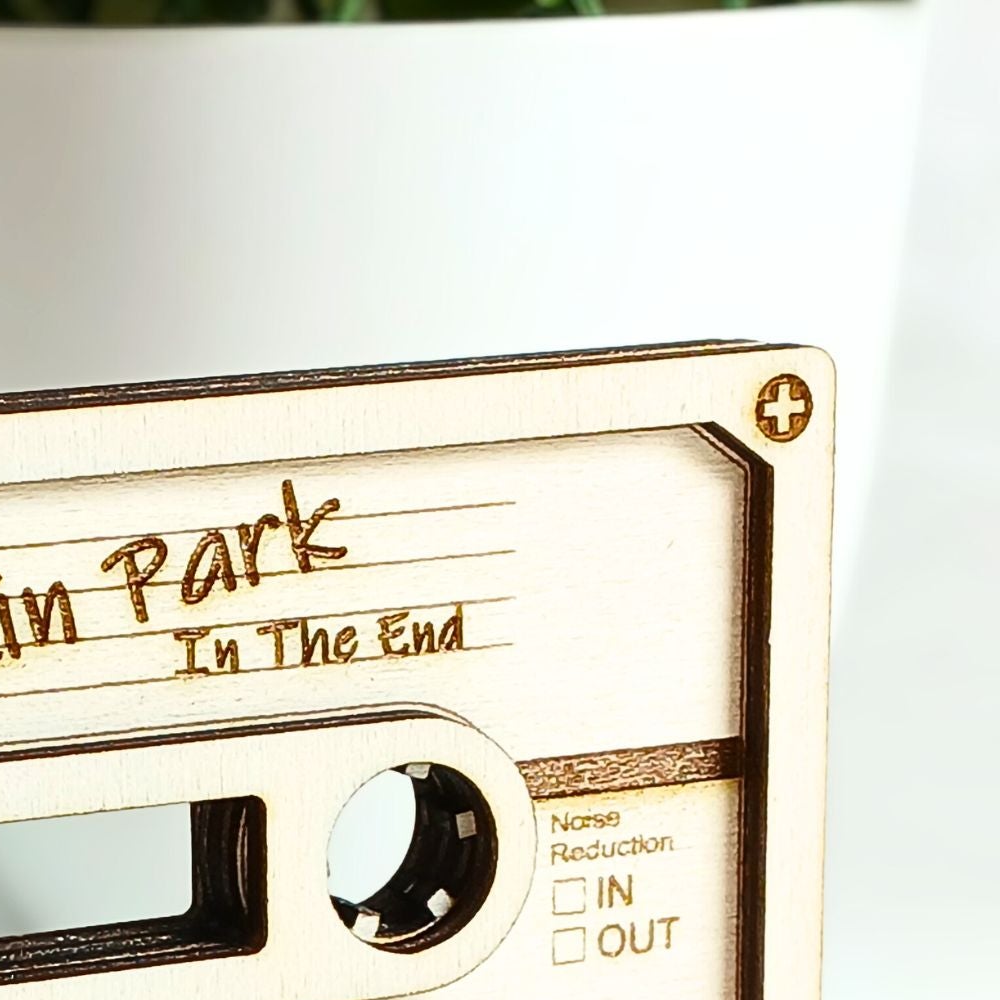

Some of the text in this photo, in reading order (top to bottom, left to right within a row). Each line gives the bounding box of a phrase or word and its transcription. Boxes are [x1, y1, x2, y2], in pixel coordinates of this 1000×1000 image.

[101, 479, 347, 622] Park
[173, 603, 463, 677] In The End
[551, 834, 674, 865] Reduction
[597, 874, 633, 909] IN
[597, 916, 680, 957] OUT
